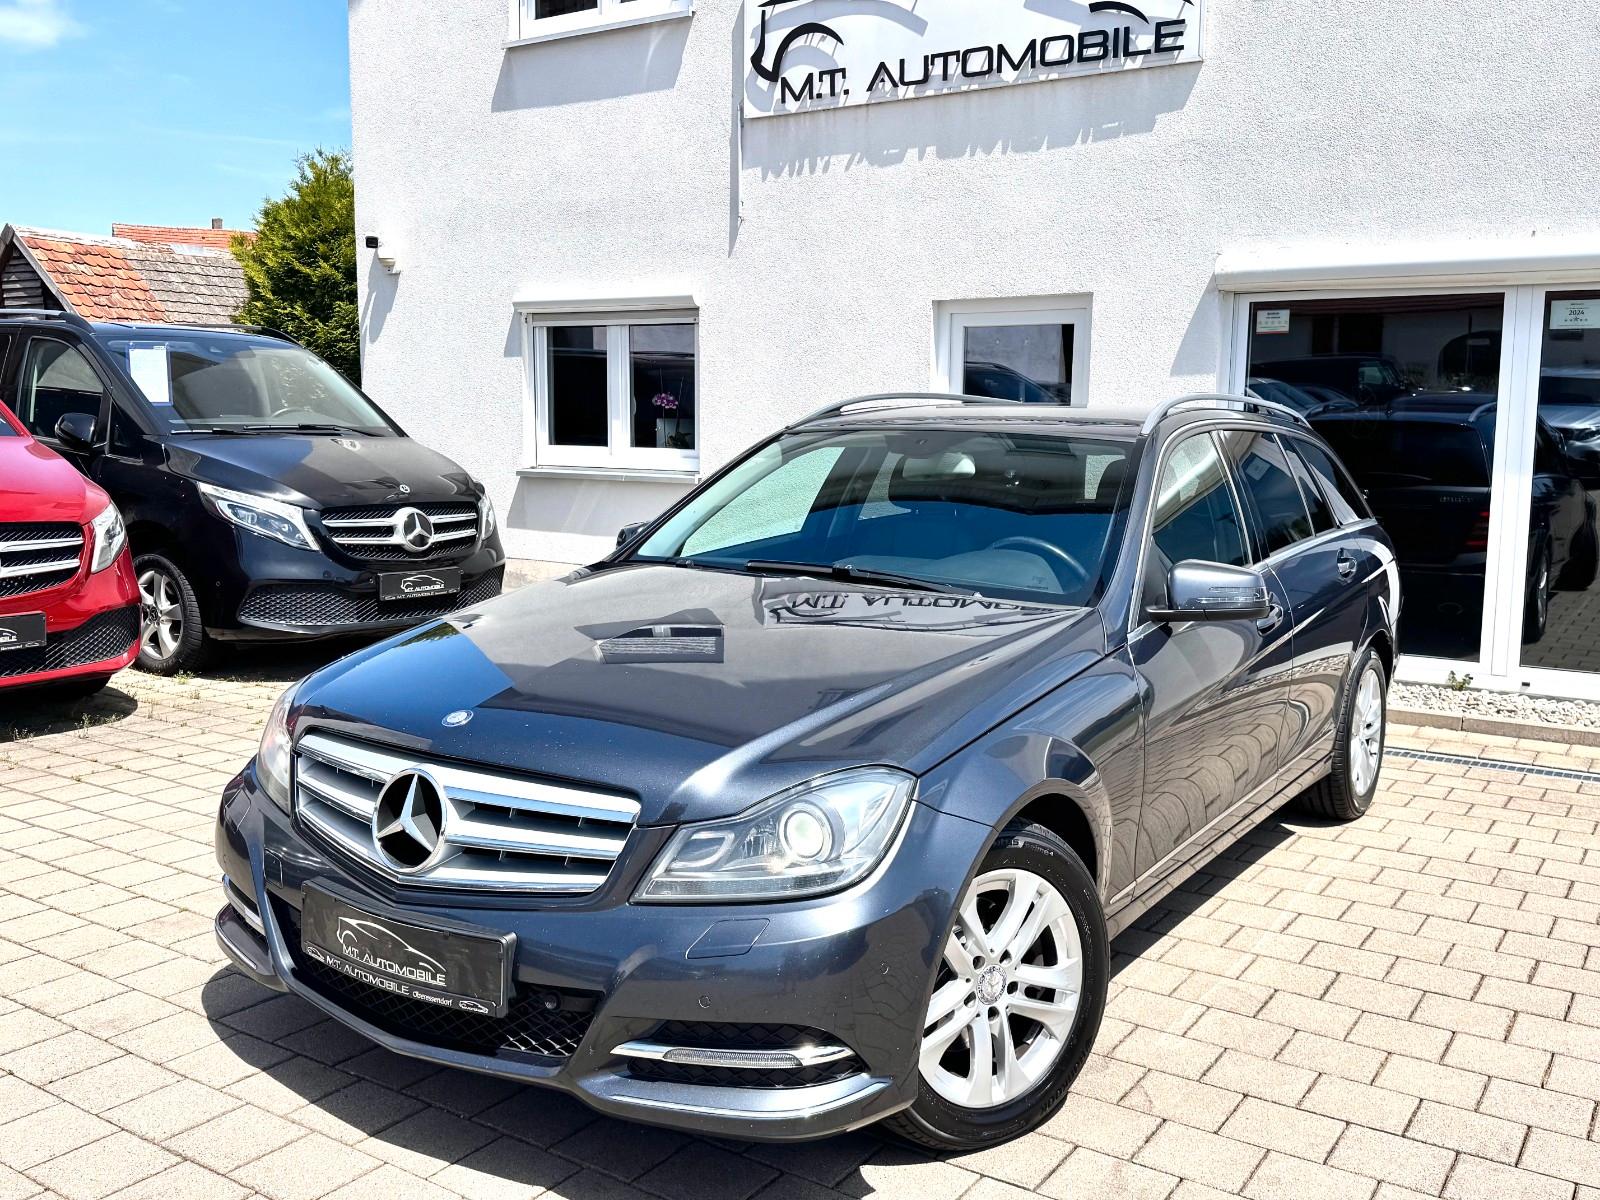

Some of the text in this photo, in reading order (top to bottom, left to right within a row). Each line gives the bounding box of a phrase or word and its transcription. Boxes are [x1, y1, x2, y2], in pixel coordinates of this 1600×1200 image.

[780, 18, 1186, 104] M.T. AUTOMOBILE
[326, 955, 342, 971] M.T.
[343, 963, 410, 995] AUTOMOBILE
[342, 943, 446, 987] M.T. AUTOMOBILE
